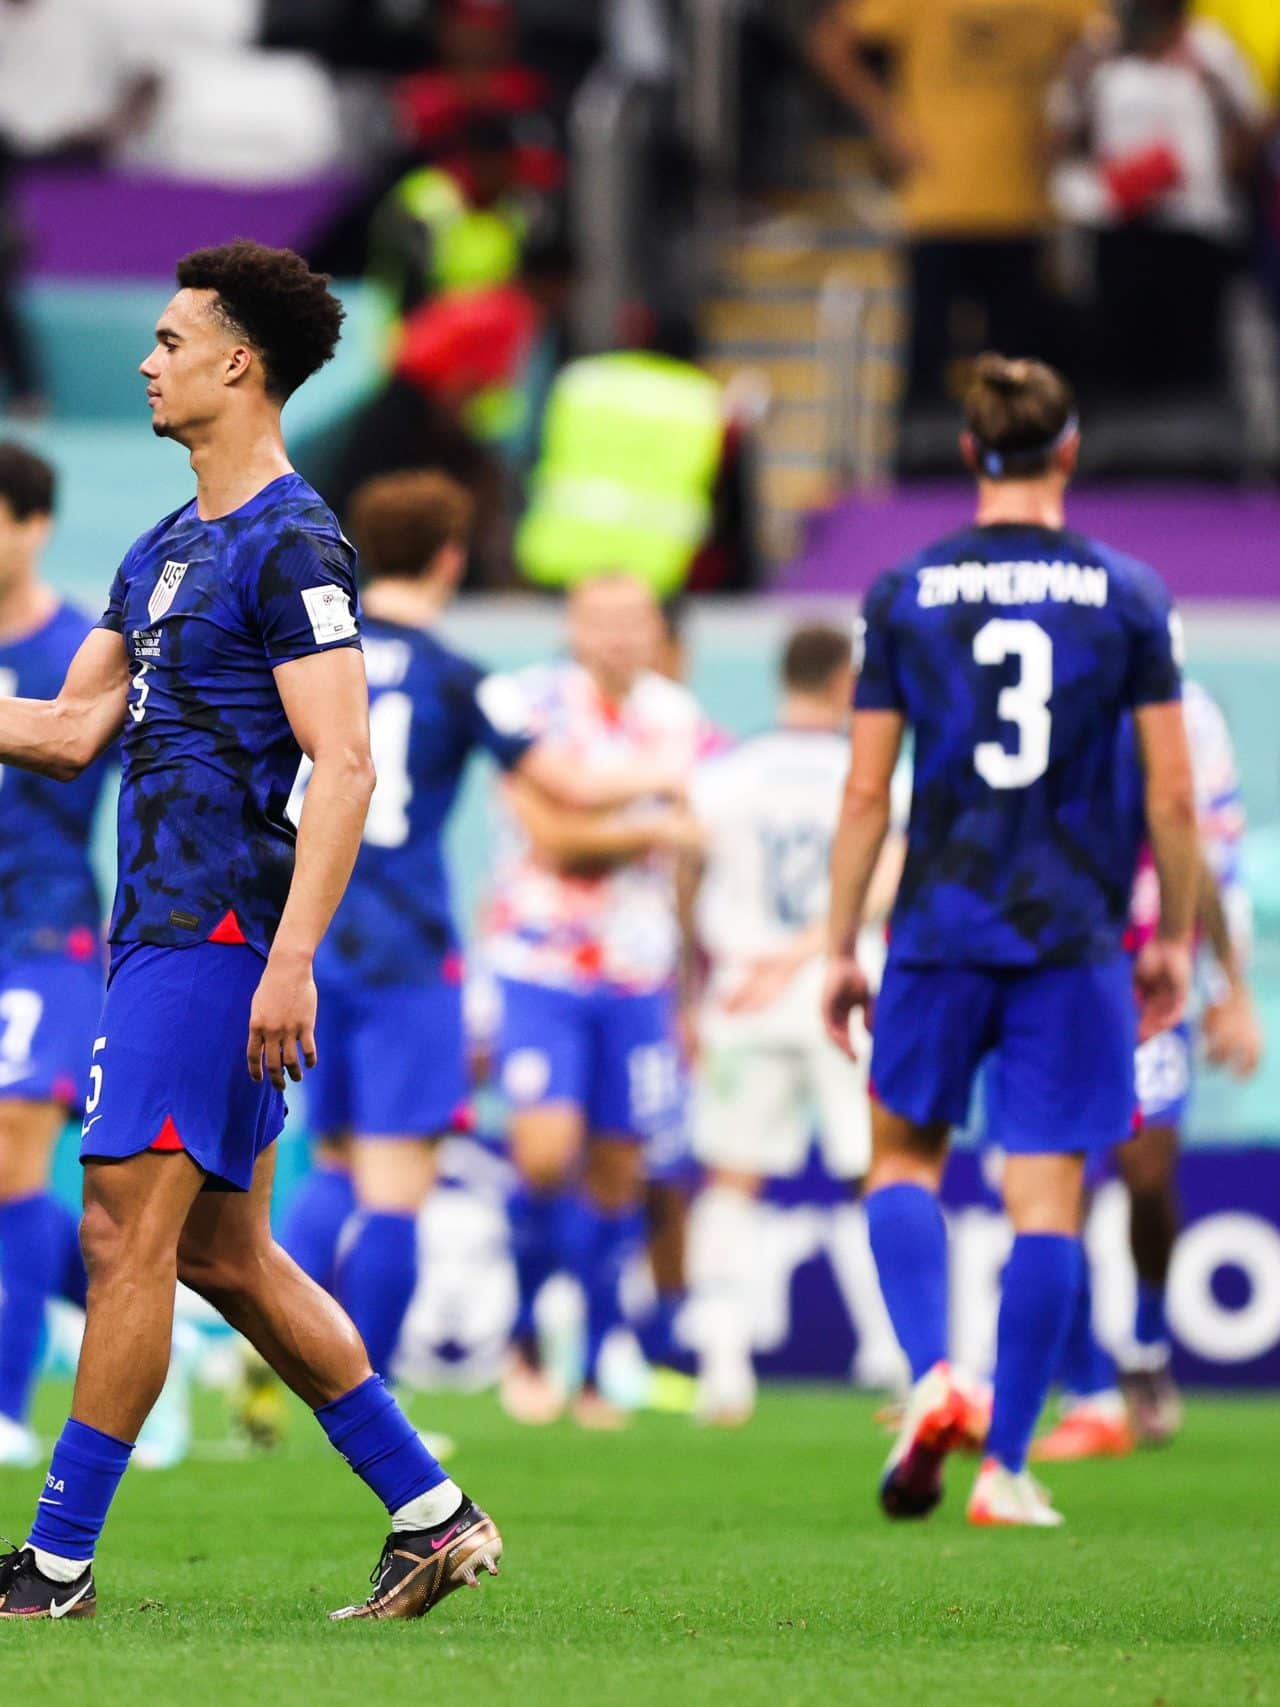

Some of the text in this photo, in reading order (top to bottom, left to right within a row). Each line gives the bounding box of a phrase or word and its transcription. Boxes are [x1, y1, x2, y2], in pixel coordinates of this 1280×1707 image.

[917, 561, 1108, 608] ZIMMERMAN
[973, 617, 1053, 789] 3
[86, 1036, 107, 1114] 5
